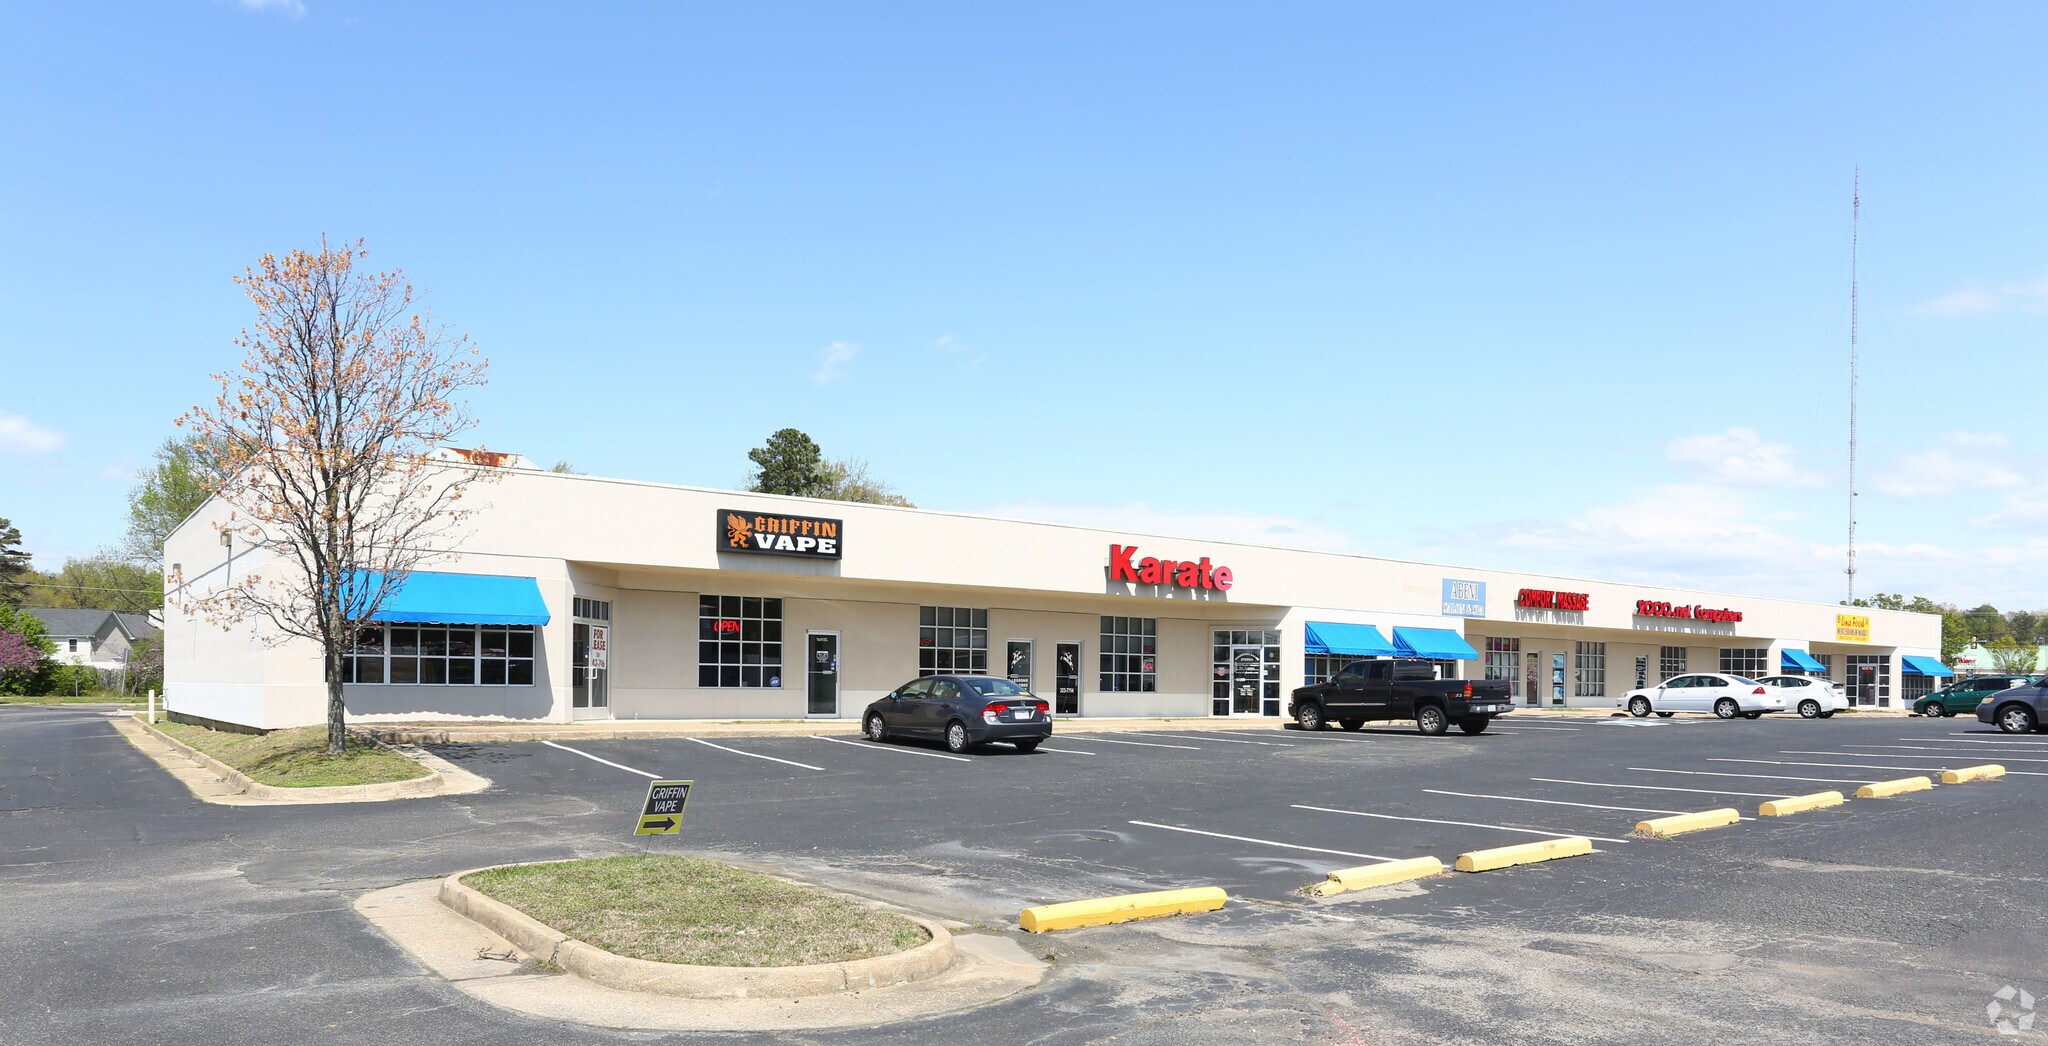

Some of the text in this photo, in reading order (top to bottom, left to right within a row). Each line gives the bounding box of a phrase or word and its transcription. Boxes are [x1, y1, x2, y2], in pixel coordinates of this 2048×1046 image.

[754, 516, 837, 538] GRIFFIN
[754, 533, 837, 554] VAPE
[1108, 544, 1233, 591] Karate
[1450, 581, 1479, 601] ABENI
[1518, 589, 1589, 611] COMFORT MASSAGE
[1694, 605, 1743, 623] Computers
[593, 629, 604, 639] FOR
[713, 620, 740, 632] OPEN
[592, 640, 606, 650] EASE
[652, 786, 688, 800] GRIFFIN
[654, 800, 678, 813] VAPE
